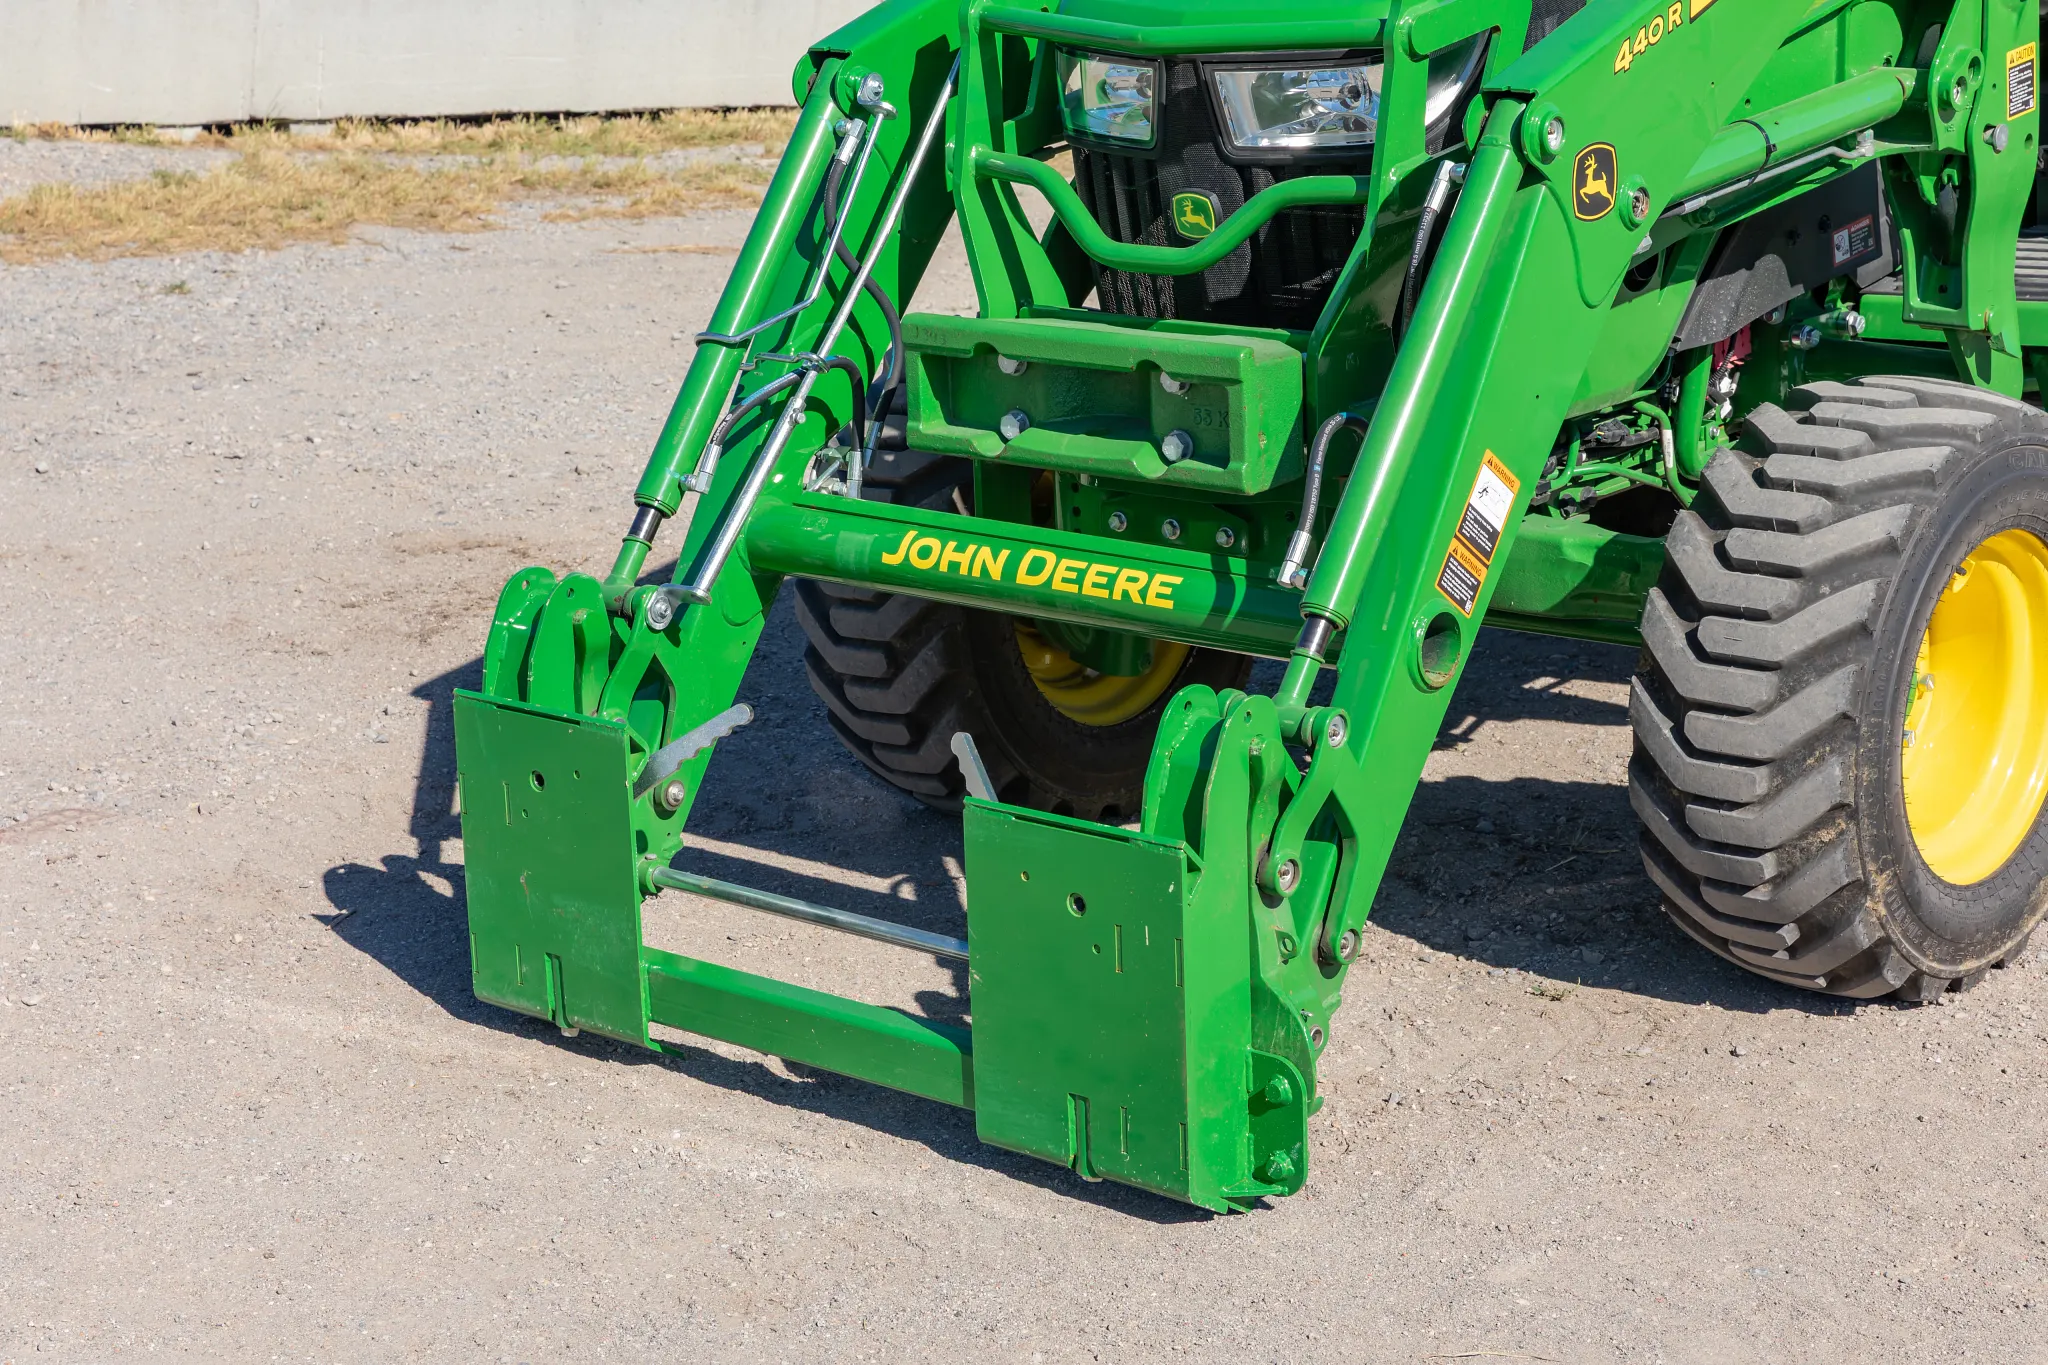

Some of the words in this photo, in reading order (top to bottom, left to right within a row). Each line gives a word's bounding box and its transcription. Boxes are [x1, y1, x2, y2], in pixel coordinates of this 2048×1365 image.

[2016, 45, 2035, 61] CAUTION
[1493, 461, 1516, 489] WARNING
[882, 530, 1012, 581] JOHN
[1016, 548, 1184, 610] DEERE
[1460, 551, 1483, 577] WARNING
